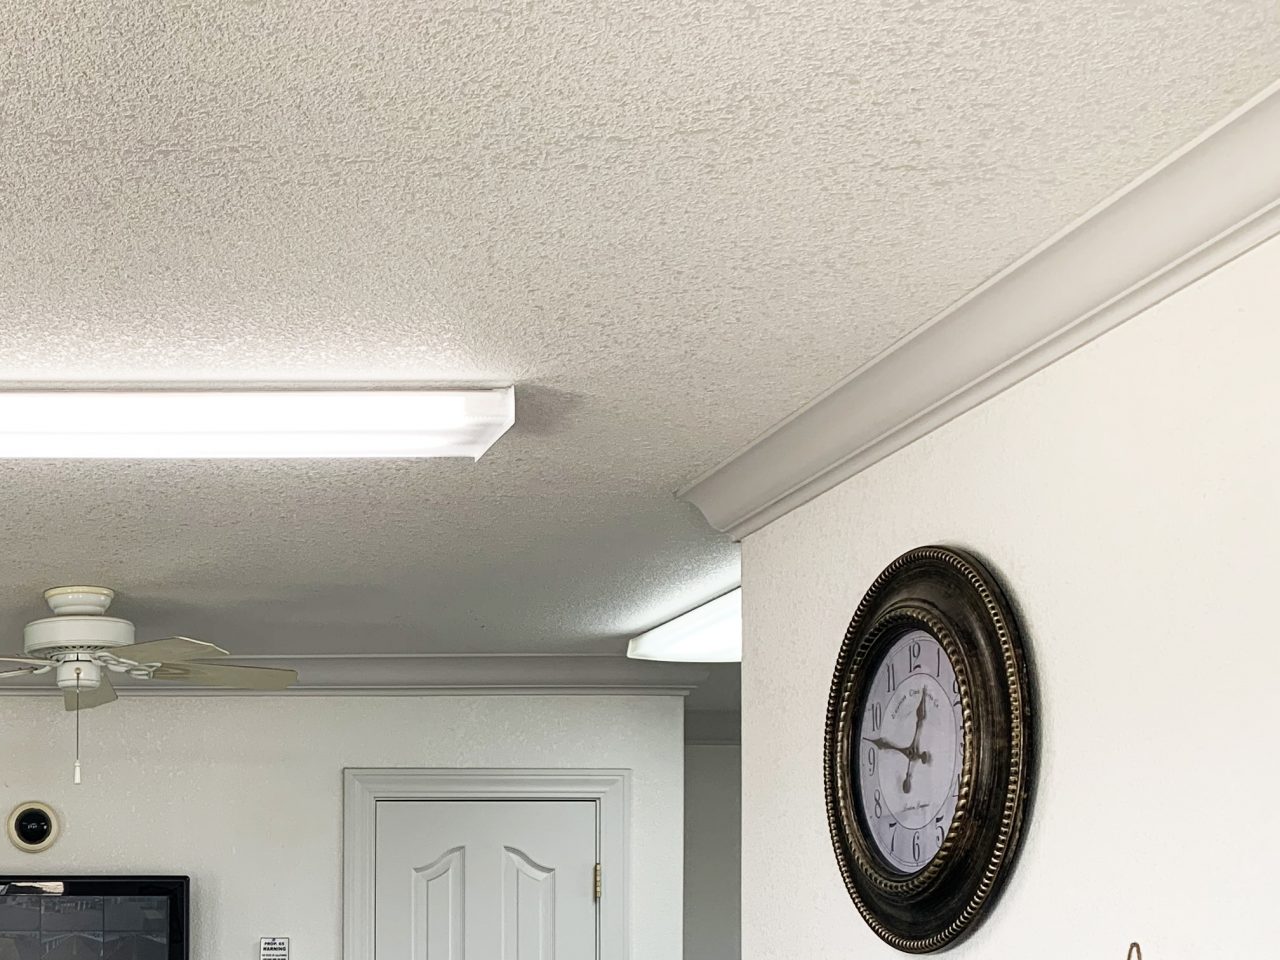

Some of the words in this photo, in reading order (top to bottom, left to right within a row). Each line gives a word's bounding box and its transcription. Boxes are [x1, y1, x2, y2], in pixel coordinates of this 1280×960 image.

[908, 641, 921, 673] 12
[886, 663, 895, 692] 11
[871, 701, 881, 732] 10
[868, 747, 876, 776] 9
[874, 789, 882, 819] 8
[888, 822, 898, 855] 7
[912, 831, 920, 862] 6
[935, 815, 945, 849] 5
